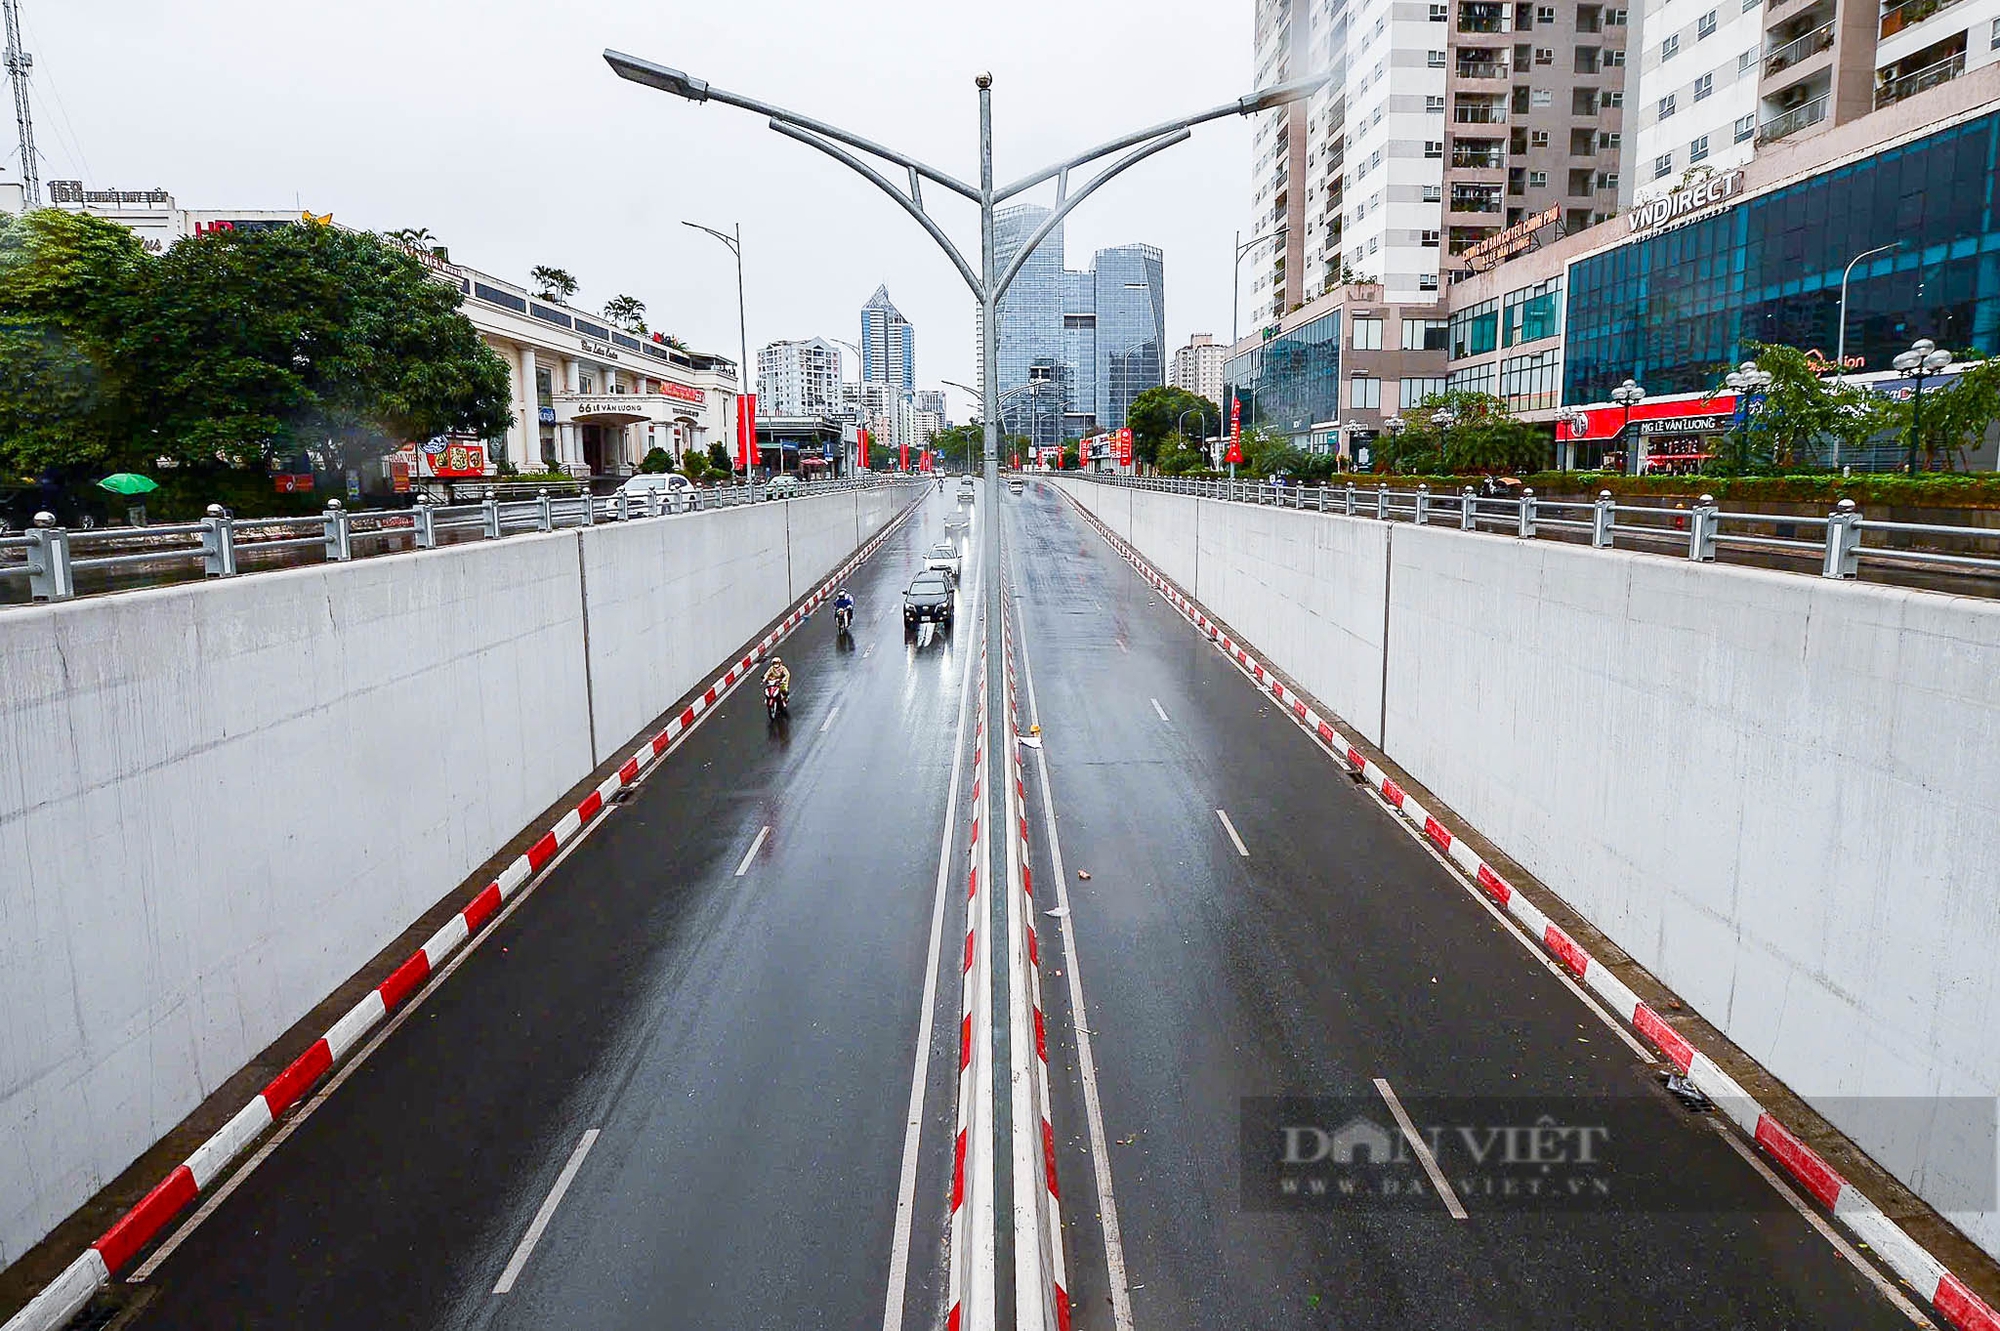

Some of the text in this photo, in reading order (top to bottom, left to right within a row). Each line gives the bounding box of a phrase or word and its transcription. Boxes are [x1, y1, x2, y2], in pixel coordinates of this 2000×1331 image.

[47, 180, 82, 202] 168
[1628, 170, 1739, 232] VNDIRECT
[1684, 205, 1732, 226] SUCCESS
[1462, 243, 1479, 261] CHUNG
[1488, 232, 1501, 250] BAN
[1523, 213, 1543, 234] CHÍNH
[578, 403, 591, 413] 66
[601, 404, 617, 412] VĂN
[1641, 422, 1653, 432] MG
[1665, 417, 1683, 431] VĂN
